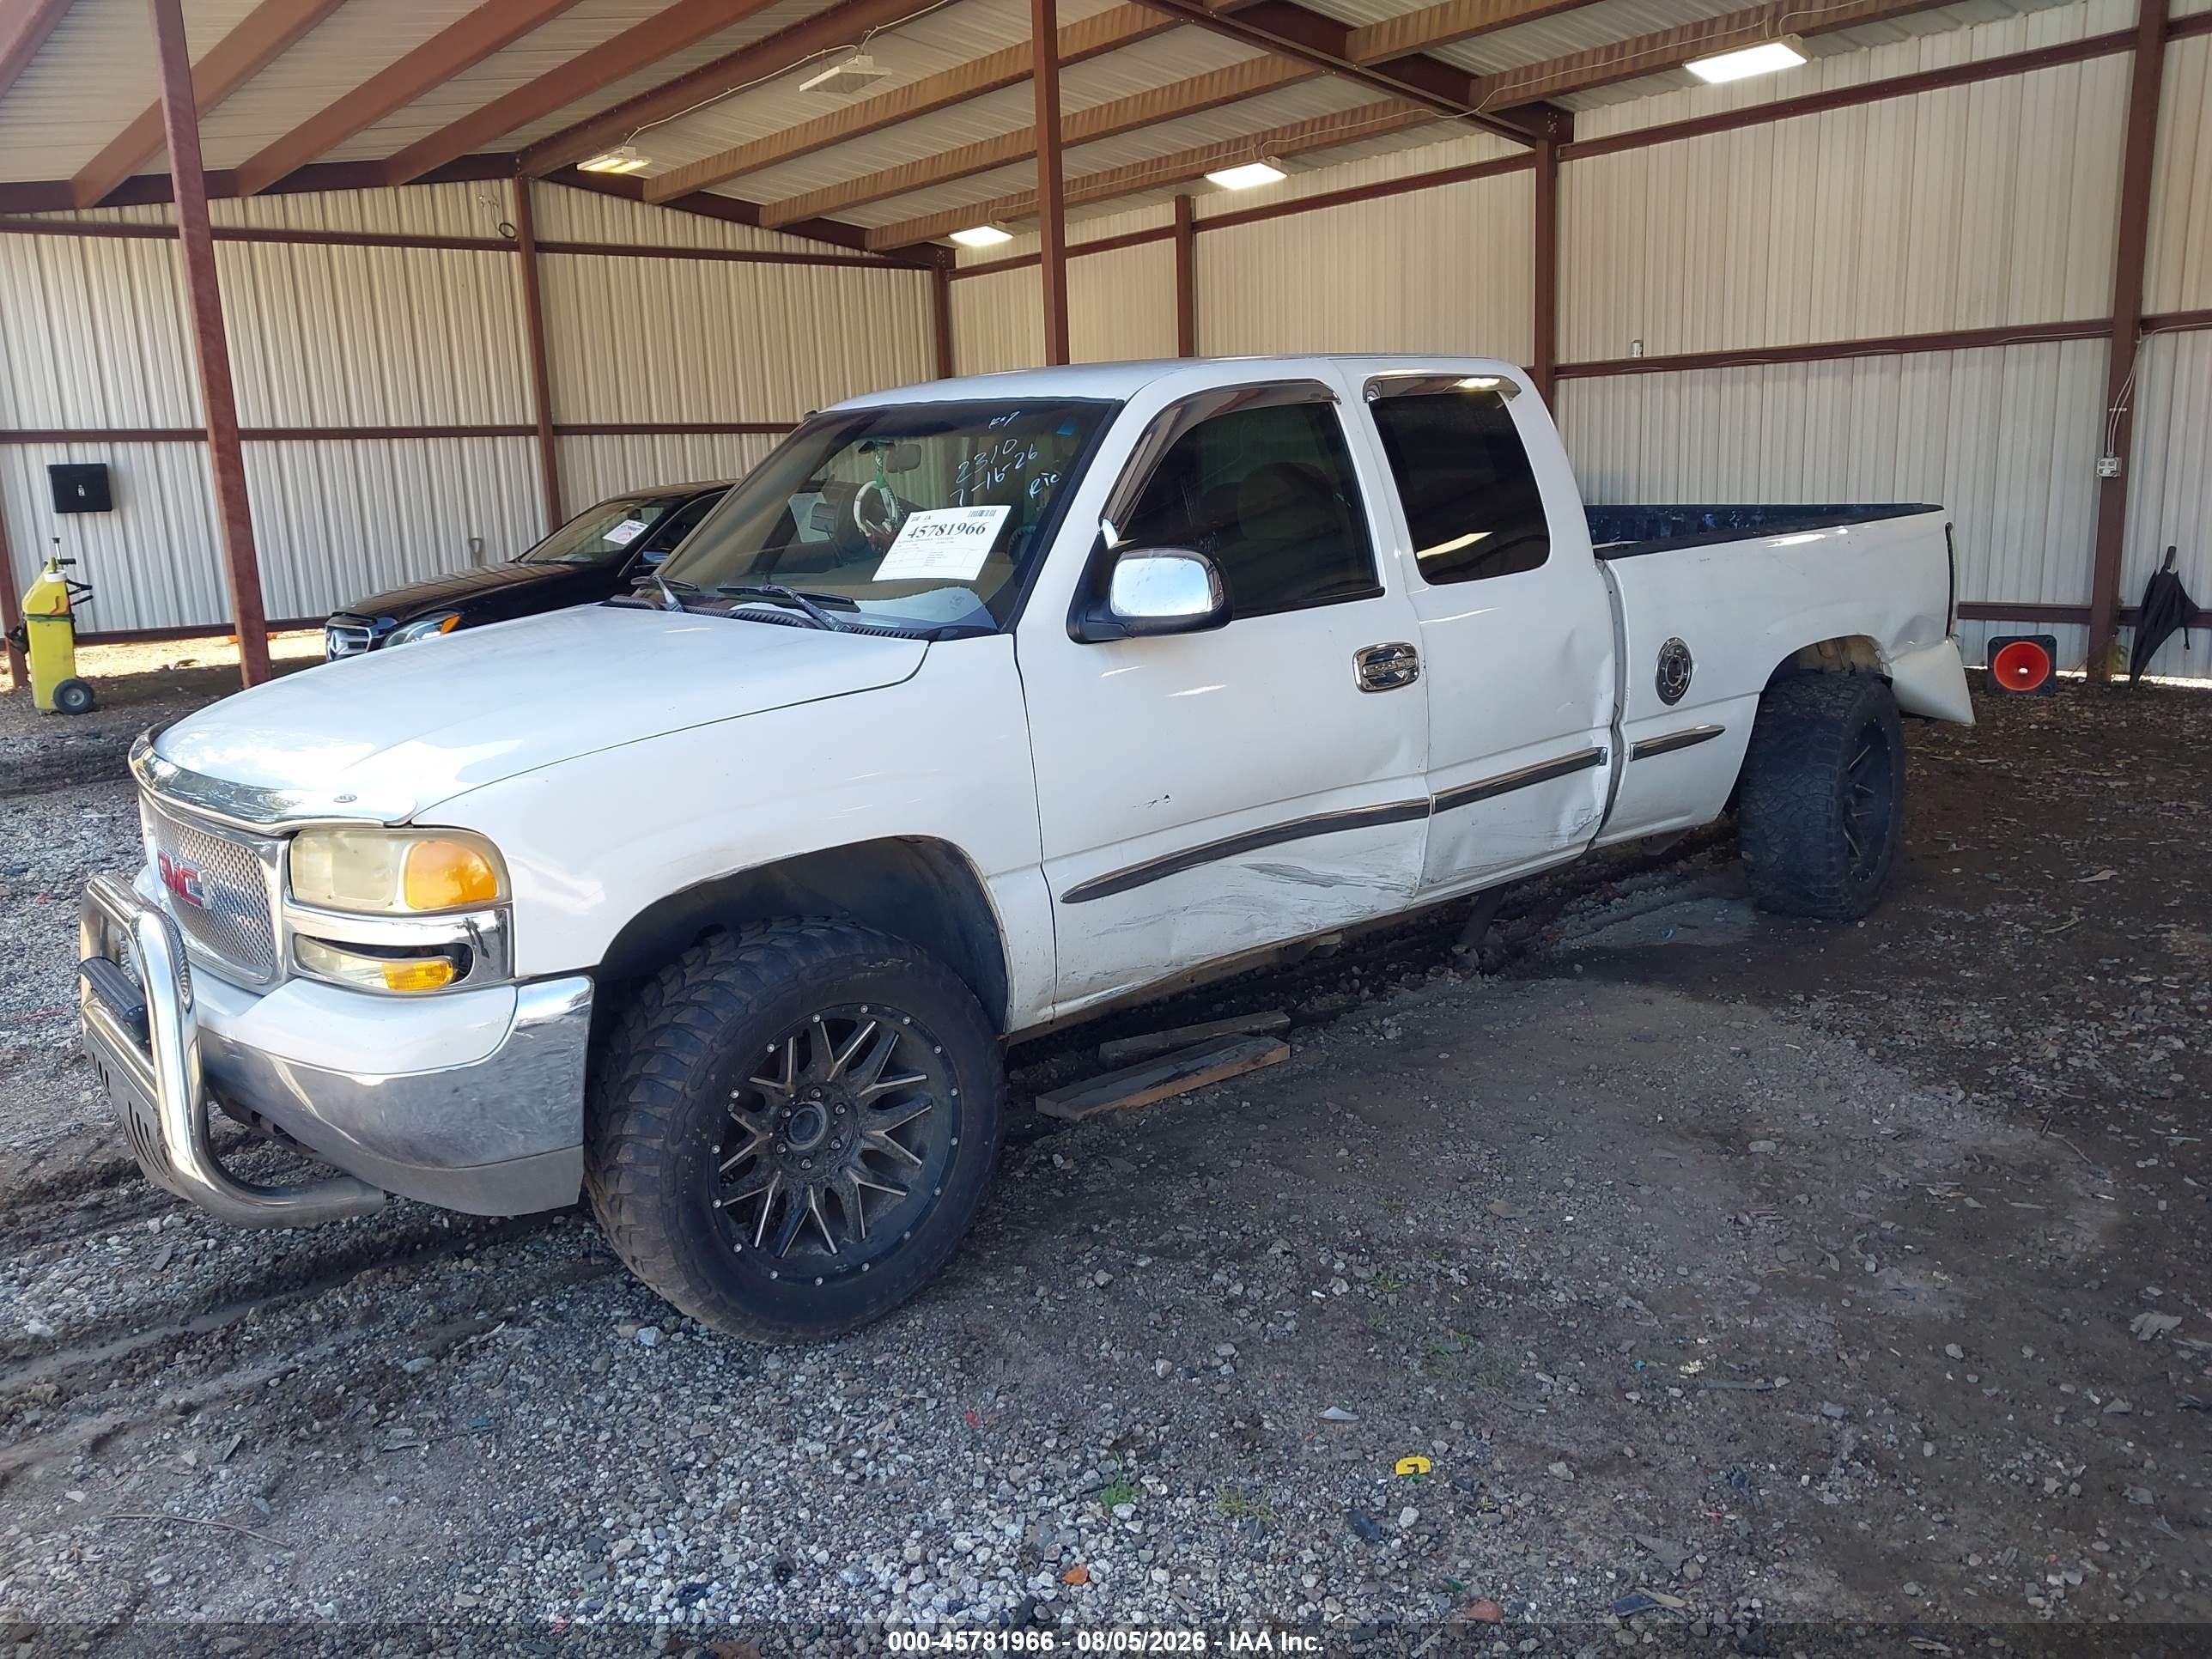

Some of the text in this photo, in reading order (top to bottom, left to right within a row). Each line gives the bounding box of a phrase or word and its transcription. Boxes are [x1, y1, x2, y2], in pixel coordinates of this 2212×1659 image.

[956, 439, 1018, 483] 2310
[908, 521, 989, 539] 45781966
[157, 848, 209, 908] GMC
